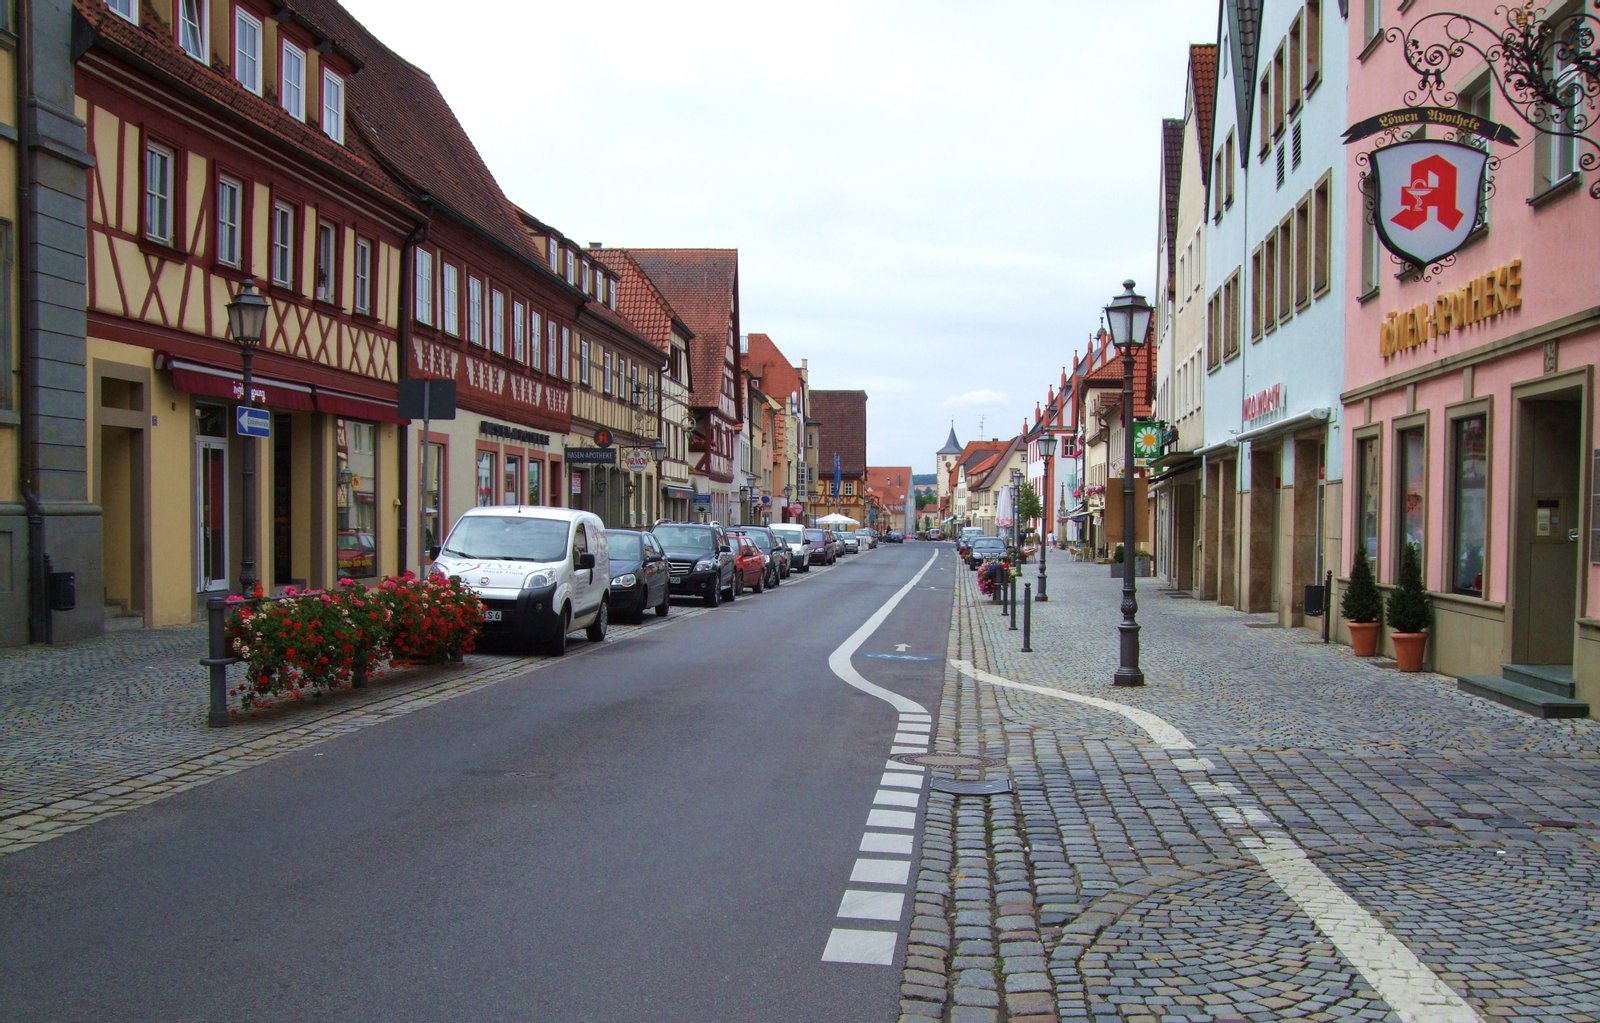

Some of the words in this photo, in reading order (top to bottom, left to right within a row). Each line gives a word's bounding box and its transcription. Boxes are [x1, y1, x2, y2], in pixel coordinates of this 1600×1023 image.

[1379, 112, 1418, 127] Löwen
[1427, 109, 1480, 130] Apotheke
[1390, 154, 1464, 231] A
[567, 451, 613, 459] HASEN-APOTHEKE
